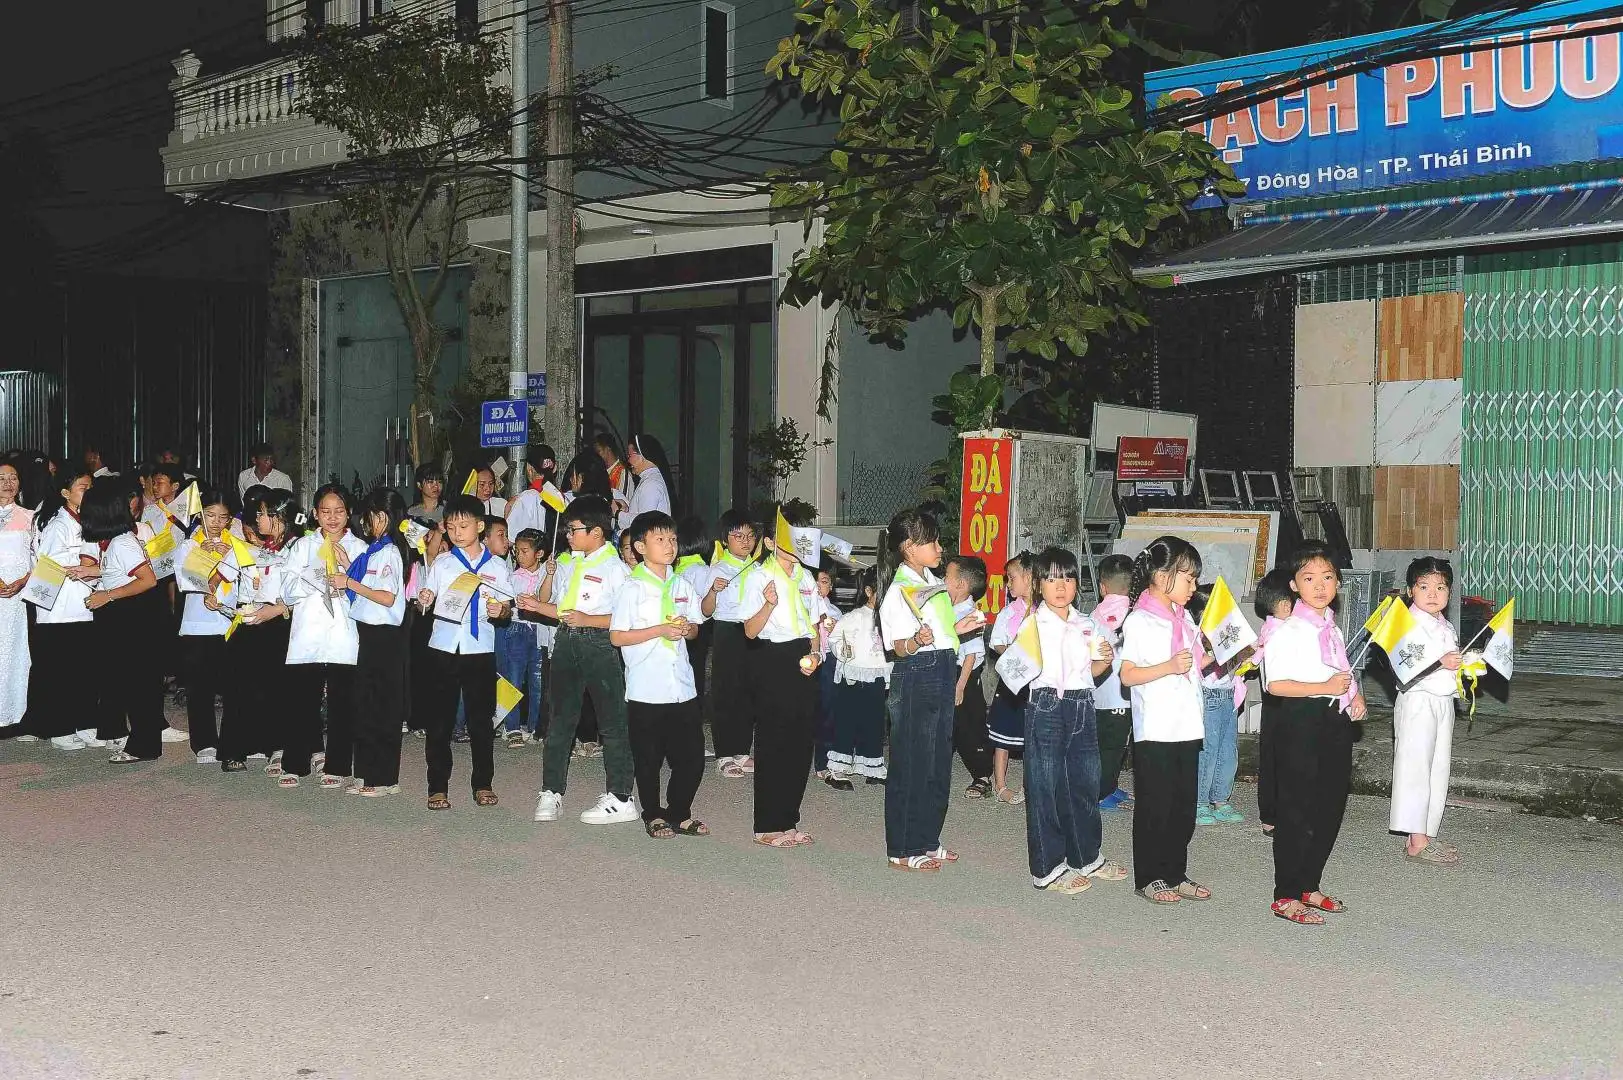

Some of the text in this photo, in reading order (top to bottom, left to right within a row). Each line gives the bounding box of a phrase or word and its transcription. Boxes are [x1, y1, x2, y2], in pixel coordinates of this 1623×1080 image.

[1257, 172, 1310, 191] Đông
[1318, 165, 1358, 183] Hòa
[1379, 157, 1411, 175] TP.
[1419, 148, 1468, 170] Thái
[1476, 142, 1532, 163] Bình
[491, 403, 517, 419] ĐÁ
[970, 441, 1003, 494] ĐÁ
[969, 494, 1000, 553] ỐP
